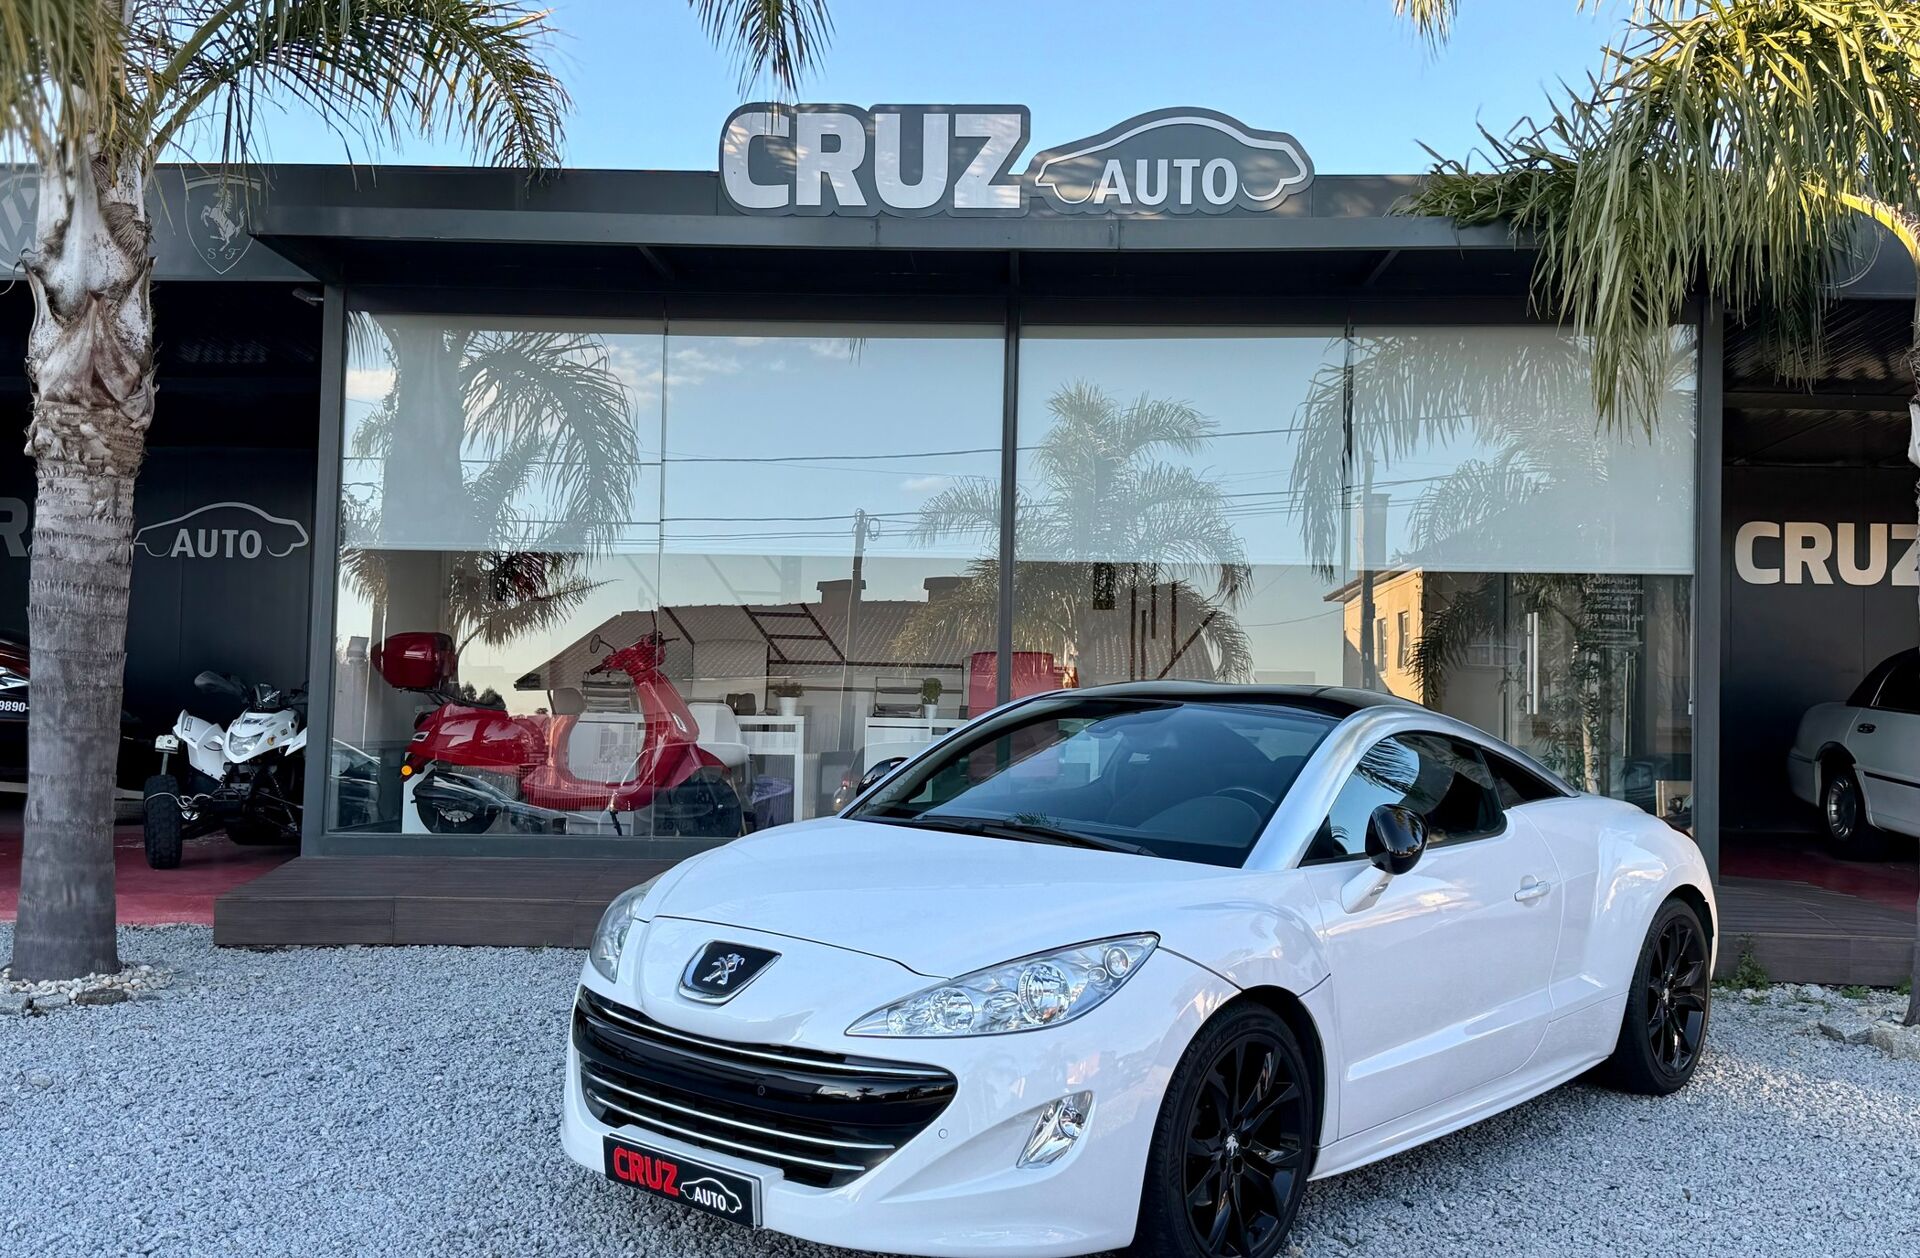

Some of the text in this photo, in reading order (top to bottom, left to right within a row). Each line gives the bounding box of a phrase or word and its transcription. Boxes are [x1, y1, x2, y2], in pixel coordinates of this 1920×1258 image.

[722, 111, 1239, 209] CRUZ AUTO
[170, 528, 262, 559] AUTO
[1735, 521, 1919, 586] CRUZ
[613, 1145, 727, 1212] CRUZ AUTO
